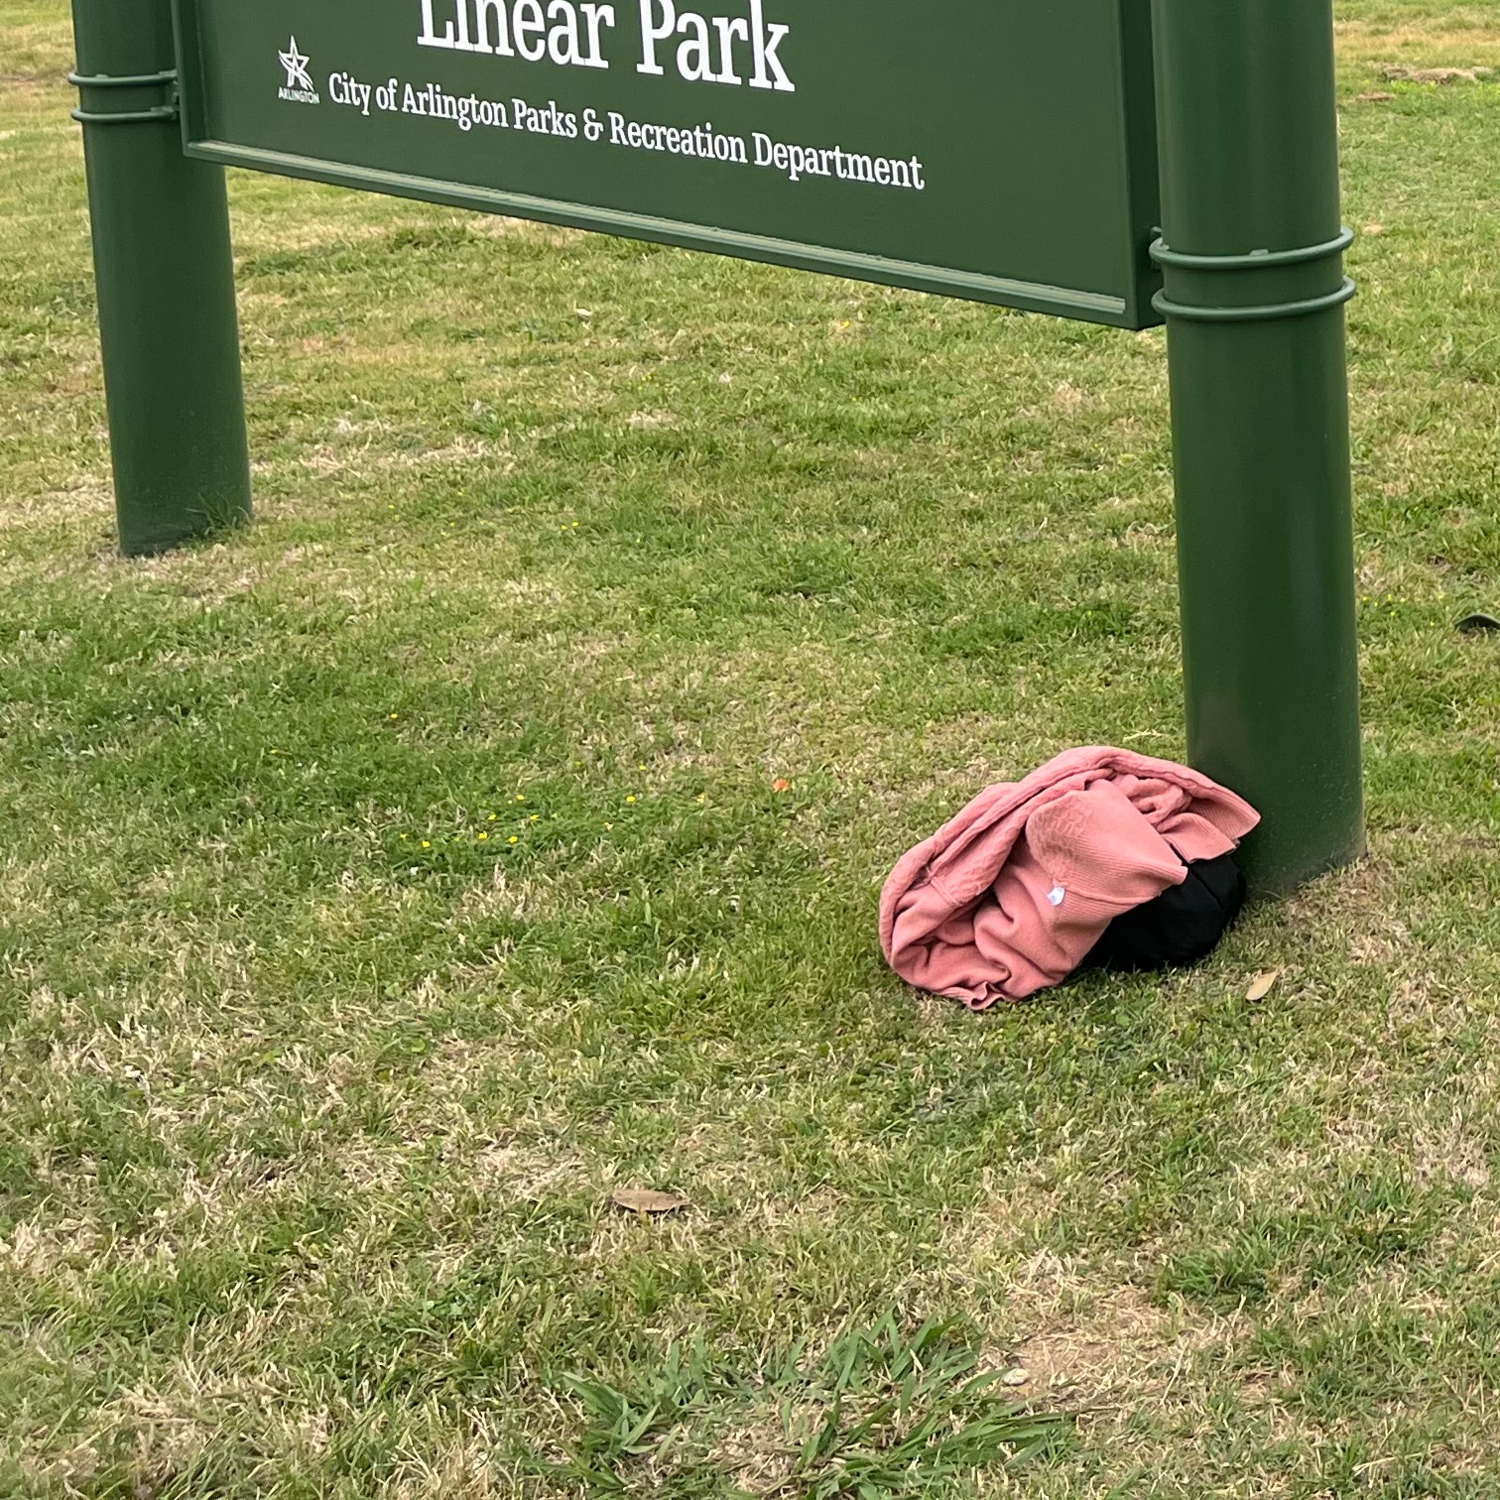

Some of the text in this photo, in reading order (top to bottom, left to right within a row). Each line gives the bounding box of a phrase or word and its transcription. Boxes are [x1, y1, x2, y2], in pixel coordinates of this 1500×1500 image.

[277, 86, 321, 105] ARLINGTON
[328, 71, 925, 190] City of Arlington Parks & Recreation Department
